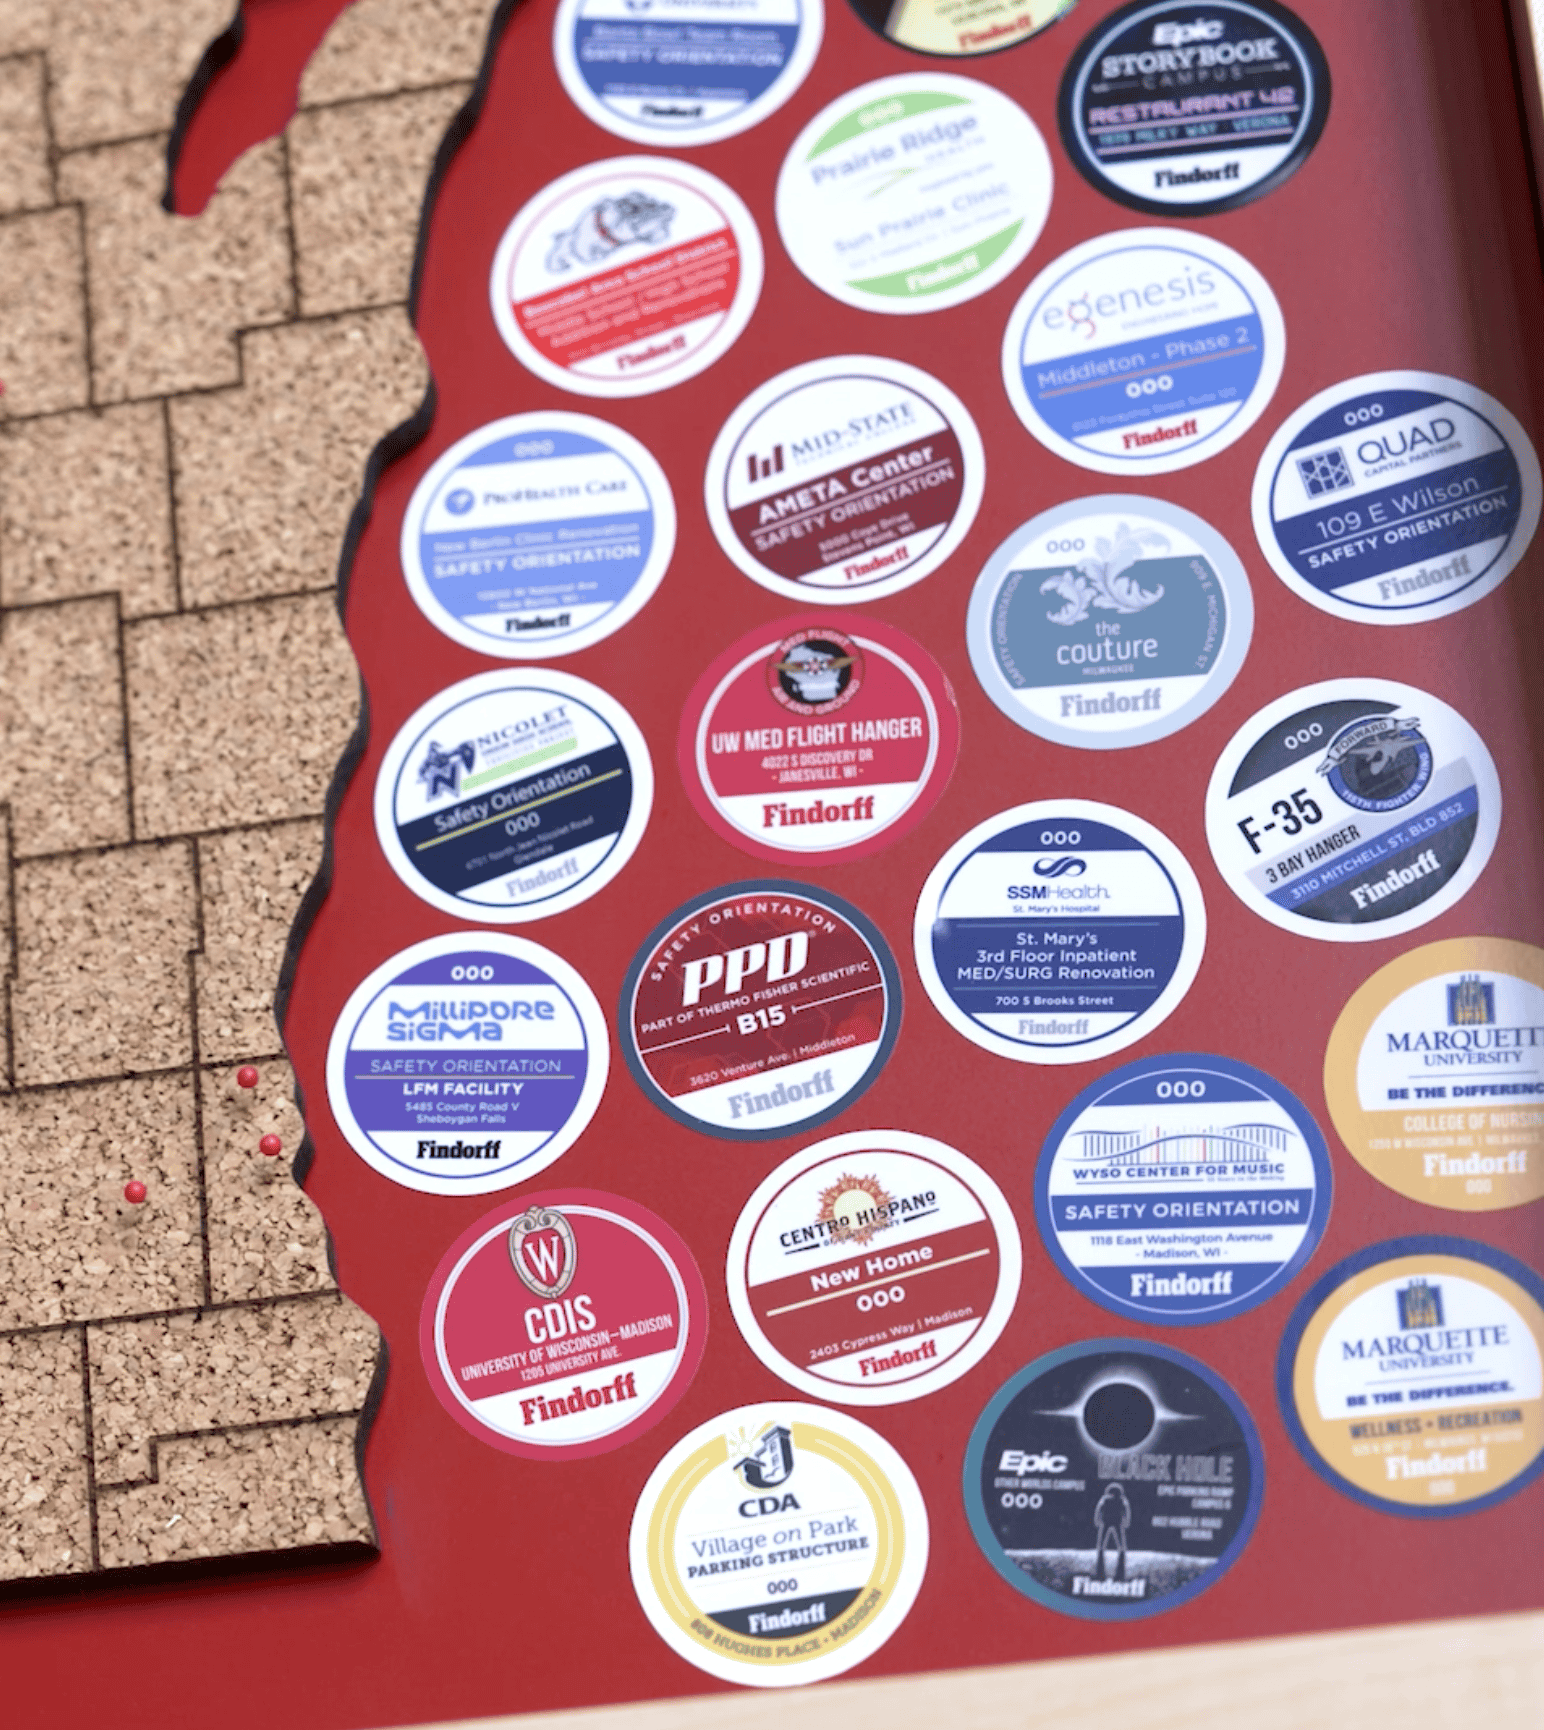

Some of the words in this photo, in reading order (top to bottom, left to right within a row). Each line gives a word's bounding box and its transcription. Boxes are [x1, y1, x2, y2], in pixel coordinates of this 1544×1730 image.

[1152, 18, 1225, 47] Epic
[1102, 37, 1279, 79] STORYBOOK
[1142, 64, 1242, 90] CAMPUS
[1088, 89, 1254, 125] RESTAURANT
[811, 146, 895, 186] Prairie
[900, 114, 977, 152] Ridge
[1155, 161, 1240, 189] Findorff
[834, 232, 873, 254] Sun
[878, 206, 946, 237] Prairie
[952, 182, 1009, 213] Clinic
[1042, 265, 1216, 340] egenesis
[1037, 353, 1146, 389] Middleton
[1164, 334, 1231, 359] Phase
[1235, 326, 1250, 345] 2
[1122, 418, 1198, 450] Findorff
[1356, 417, 1456, 466] QUAD
[1364, 459, 1407, 478] CAPITAL
[1409, 440, 1463, 463] PARTNERS
[759, 477, 848, 525] AMETA
[850, 445, 934, 488] Center
[755, 513, 827, 552] SAFETY
[830, 465, 956, 523] ORIENTATION
[1316, 510, 1362, 540] 109
[1368, 502, 1388, 524] E
[1392, 476, 1480, 514] Wilson
[1308, 536, 1379, 569] SAFETY
[1383, 494, 1508, 545] ORIENTATION
[433, 556, 506, 580] SAFETY
[511, 543, 641, 571] ORIENTATION
[843, 545, 909, 580] Findorff
[1377, 553, 1473, 601] Findorff
[506, 613, 571, 632] Findorff
[1094, 620, 1122, 637] the
[1056, 636, 1159, 666] couture
[1082, 663, 1135, 676] MILWAUKEE
[1060, 687, 1162, 718] Findorff
[476, 704, 568, 748] NICOLET
[711, 731, 741, 754] UW
[744, 727, 783, 751] MED
[786, 722, 847, 748] FLIGHT
[851, 716, 923, 744] HANGER
[1334, 721, 1388, 754] FORWARD
[800, 749, 857, 767] DISCOVERY
[858, 748, 874, 762] DR
[1375, 781, 1423, 810] FIGHTER
[1417, 750, 1430, 784] WING
[433, 802, 490, 833] Safety
[490, 763, 592, 812] Orientation
[762, 795, 875, 828] Findorff
[1236, 787, 1324, 856] F-35
[1265, 868, 1279, 884] 3
[1277, 853, 1306, 879] BAY
[1306, 824, 1361, 866] HANGER
[1290, 878, 1320, 900] 3110
[1320, 842, 1388, 885] MITCHELL
[1411, 816, 1437, 838] BLD
[1438, 802, 1464, 822] 852
[505, 856, 580, 898] Findorff
[1349, 849, 1441, 910] Findorff
[1012, 905, 1025, 913] St.
[1028, 905, 1058, 914] Mary's
[1061, 903, 1101, 914] Hospital
[651, 922, 702, 982] SAFETY
[708, 901, 837, 934] ORIENTATION
[1016, 932, 1038, 945] St.
[1044, 931, 1098, 947] Mary's
[976, 950, 1005, 963] 3rd
[1010, 949, 1054, 963] Floor
[1060, 948, 1137, 964] Inpatient
[957, 967, 1053, 981] MED/SURG
[1058, 966, 1155, 980] Renovation
[640, 1016, 673, 1034] PART
[676, 1010, 695, 1025] OF
[697, 995, 751, 1018] THERMO
[753, 982, 799, 1003] FISHER
[801, 960, 870, 988] SCIENTIFIC
[995, 996, 1019, 1006] 700
[1022, 996, 1030, 1006] S
[1033, 995, 1074, 1006] Brooks
[1078, 995, 1114, 1006] Street
[736, 1005, 786, 1035] B15
[1018, 1018, 1089, 1035] Findorff
[370, 1059, 438, 1074] SAFETY
[442, 1058, 562, 1074] ORIENTATION
[720, 1059, 764, 1078] Venture
[799, 1033, 856, 1056] Middleton
[1423, 1050, 1524, 1068] UNIVERSITY
[403, 1082, 438, 1096] LFM
[443, 1082, 524, 1096] FACILITY
[727, 1068, 835, 1120] Findorff
[1387, 1087, 1410, 1100] BE
[1414, 1086, 1447, 1099] THE
[416, 1114, 478, 1125] Sheboygan
[480, 1114, 506, 1124] Falls
[436, 1101, 476, 1113] County
[479, 1101, 508, 1112] Road
[510, 1102, 520, 1111] V
[1403, 1114, 1465, 1132] COLLEGE
[1468, 1114, 1486, 1129] OF
[416, 1140, 501, 1160] Findorff
[1422, 1149, 1527, 1177] Findorff
[1073, 1168, 1122, 1180] WYSO
[1126, 1166, 1190, 1178] CENTER
[1196, 1165, 1228, 1176] FOR
[1233, 1162, 1285, 1174] MUSIC
[1064, 1202, 1147, 1222] SAFETY
[1152, 1199, 1300, 1218] ORIENTATION
[1090, 1235, 1113, 1246] 1118
[1116, 1234, 1144, 1246] East
[1146, 1233, 1223, 1247] Washington
[1226, 1232, 1274, 1244] Avenue
[1143, 1247, 1200, 1260] Madison,
[525, 1235, 559, 1282] W
[809, 1265, 861, 1292] New
[865, 1246, 934, 1276] Home
[1129, 1270, 1234, 1298] Findorff
[523, 1294, 597, 1344] CDIS
[808, 1343, 840, 1360] 2403
[841, 1330, 888, 1352] Cypress
[890, 1320, 916, 1338] Way
[924, 1305, 974, 1328] Madison
[1341, 1323, 1510, 1361] MARQUETTE
[461, 1351, 528, 1382] UNIVERSITY
[529, 1346, 544, 1364] OF
[545, 1350, 599, 1376] UNIVERSITY
[858, 1340, 938, 1378] Findorff
[1378, 1351, 1474, 1373] UNIVERSITY
[519, 1371, 638, 1427] Findorff
[1346, 1395, 1367, 1408] BE
[1372, 1391, 1404, 1405] THE
[1349, 1416, 1423, 1440] WELLNESS
[1437, 1408, 1524, 1432] RECREATION
[998, 1450, 1069, 1476] Epic
[1097, 1452, 1172, 1481] BLACK
[1175, 1454, 1234, 1484] HOLE
[1385, 1446, 1487, 1481] Findorff
[738, 1492, 802, 1518] CDA
[691, 1533, 768, 1559] Village
[772, 1528, 803, 1546] on
[808, 1514, 859, 1540] Park
[687, 1554, 764, 1578] PARKING
[768, 1536, 870, 1565] STRUCTURE
[1072, 1576, 1146, 1598] Findorff
[748, 1602, 826, 1634] Findorff
[829, 1587, 883, 1642] MADISON
